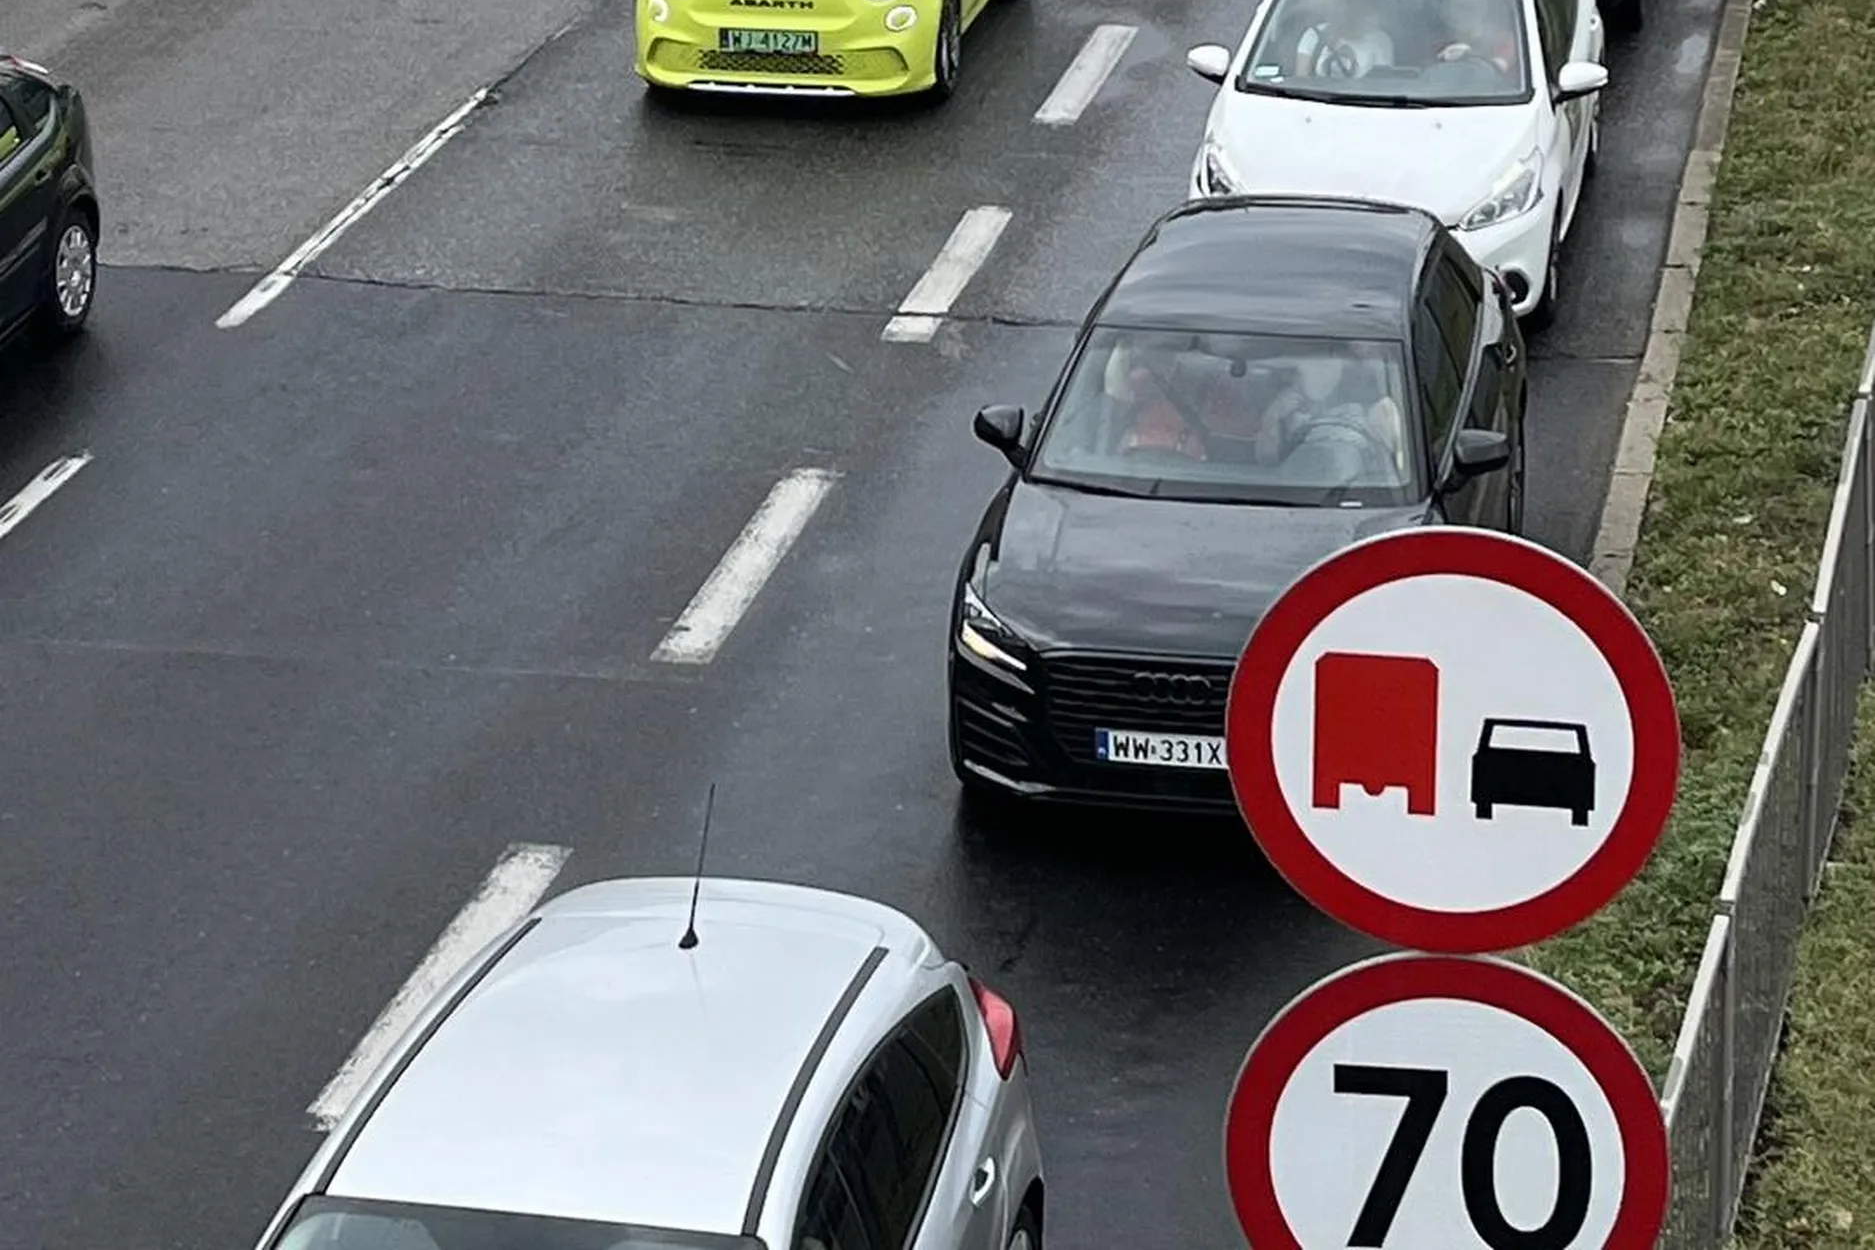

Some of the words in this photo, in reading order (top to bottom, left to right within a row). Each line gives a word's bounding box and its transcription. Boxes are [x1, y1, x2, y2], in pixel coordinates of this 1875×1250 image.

[1113, 735, 1150, 760] WW
[1160, 739, 1223, 764] 331X
[1333, 1063, 1593, 1250] 70
